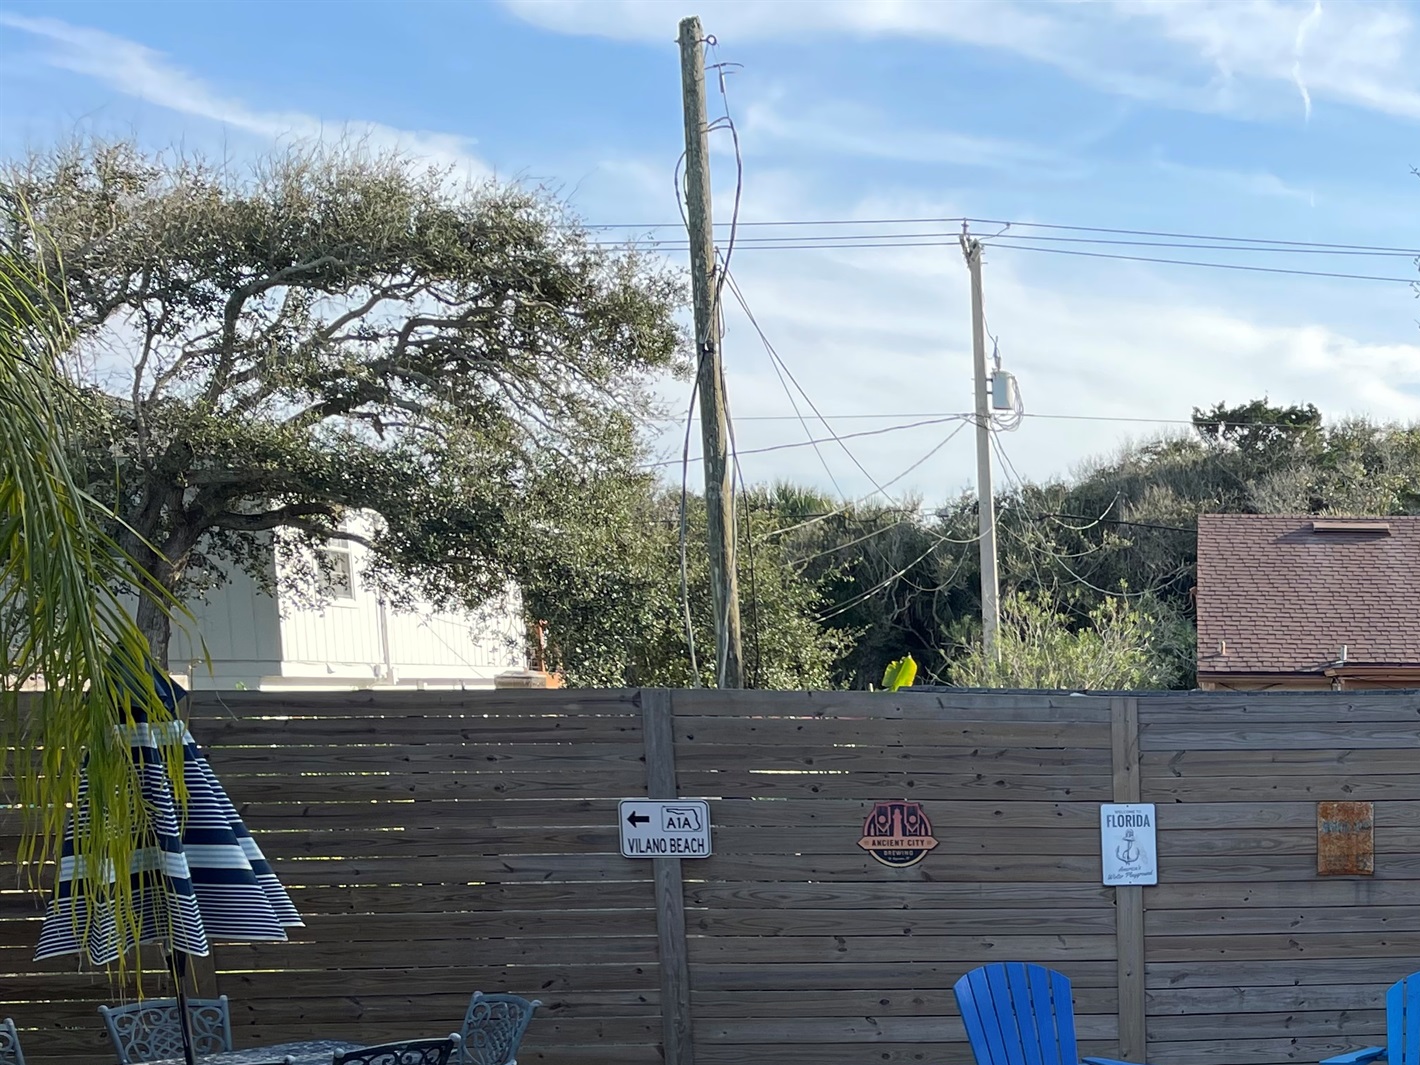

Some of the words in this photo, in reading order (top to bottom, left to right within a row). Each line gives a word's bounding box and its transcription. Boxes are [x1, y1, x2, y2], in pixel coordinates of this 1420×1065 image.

[666, 817, 692, 829] A1A
[1106, 814, 1151, 828] FLORIDA
[627, 838, 667, 853] VILANO
[669, 838, 705, 853] BEACH
[871, 839, 904, 847] ANCIENT
[907, 839, 925, 847] CITY
